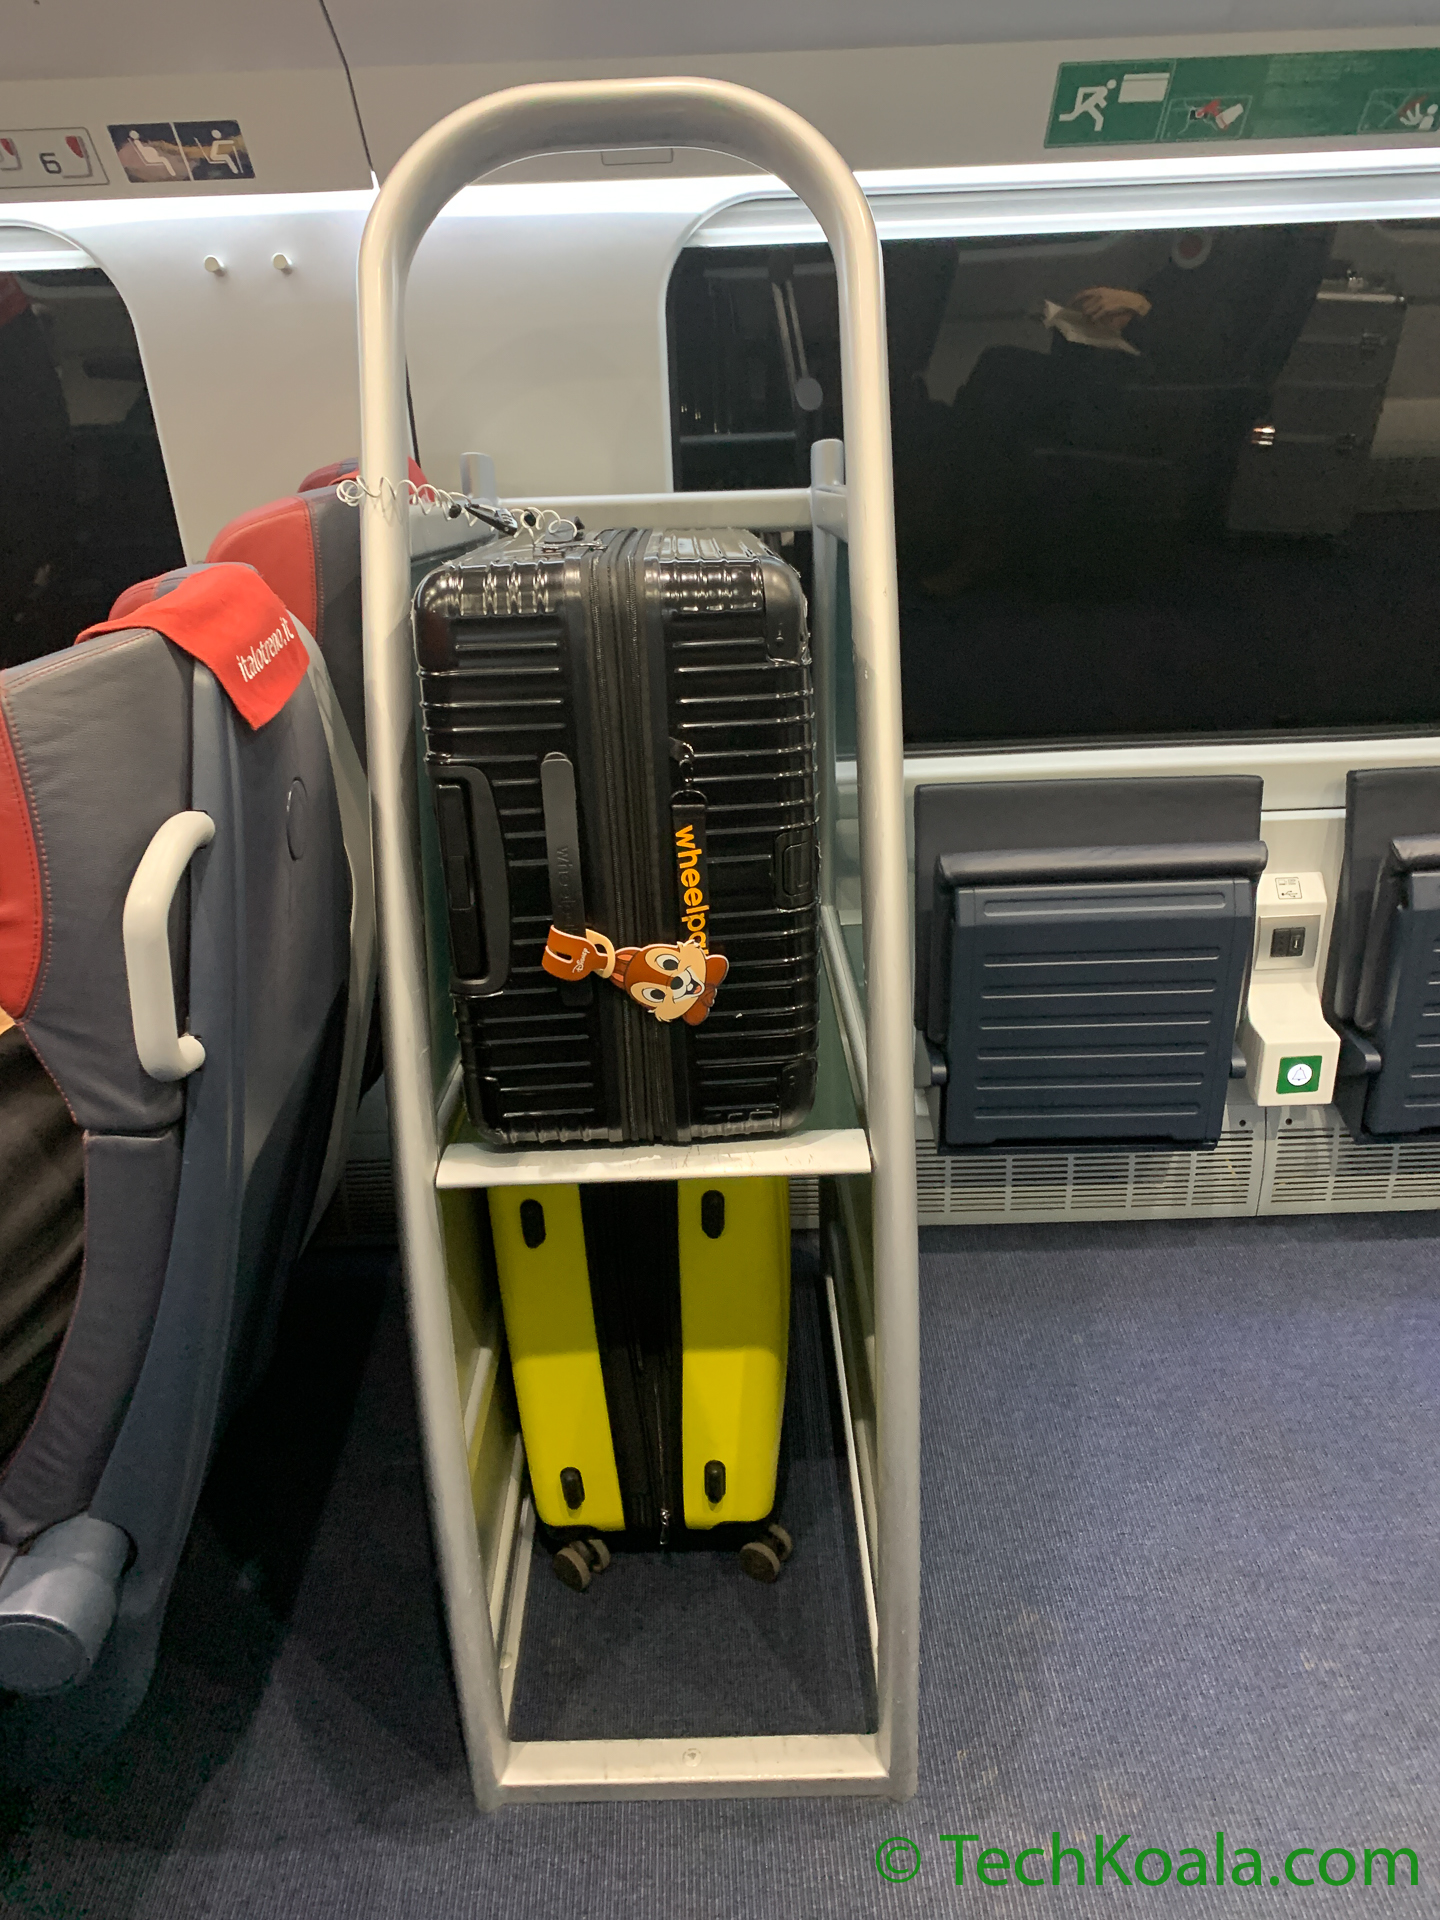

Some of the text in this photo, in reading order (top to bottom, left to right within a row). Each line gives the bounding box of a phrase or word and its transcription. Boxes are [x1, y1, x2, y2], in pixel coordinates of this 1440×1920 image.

[40, 152, 62, 174] 6
[235, 616, 295, 683] italotreno.it
[675, 824, 709, 955] wheelpa
